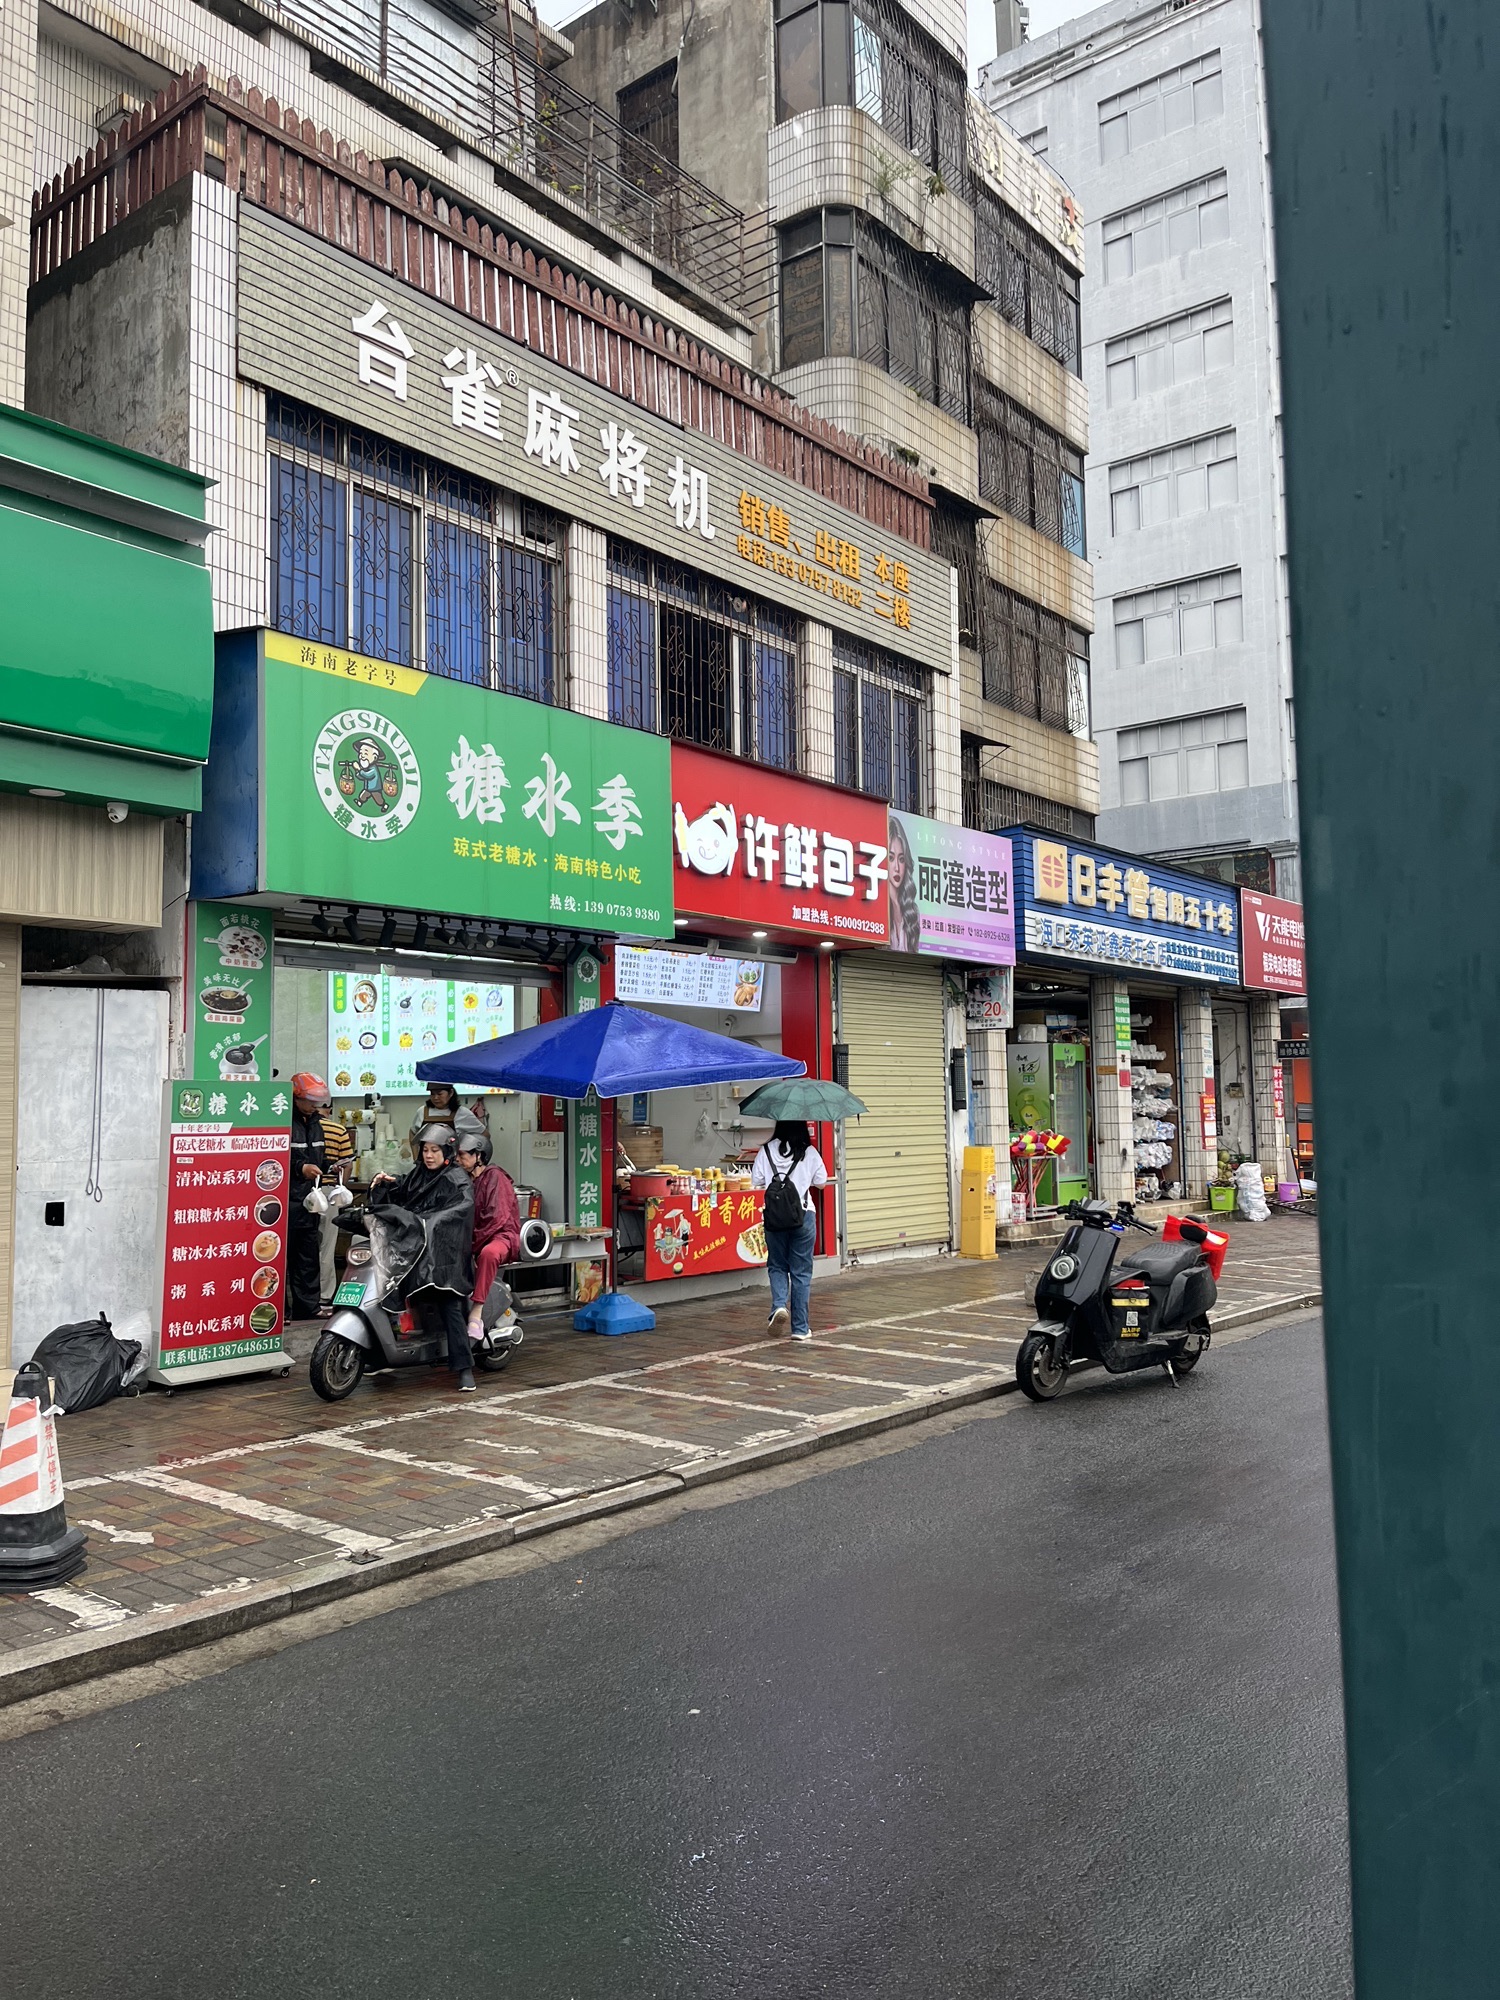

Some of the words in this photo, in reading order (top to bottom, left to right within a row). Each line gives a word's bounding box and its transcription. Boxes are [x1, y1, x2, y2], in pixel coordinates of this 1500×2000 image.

[351, 299, 716, 541] 台雀麻将机
[738, 490, 861, 581] 销售、出租
[874, 552, 910, 594] 本座
[873, 592, 911, 631] 二楼
[300, 645, 397, 687] 海南老字号
[316, 712, 419, 788] TANGSHUIJI
[445, 734, 644, 851] 糖水季
[334, 804, 403, 838] 糖水季
[744, 812, 889, 901] 许鲜包子
[917, 832, 962, 850] LITONG
[971, 845, 1005, 860] STYLE
[918, 856, 1009, 915] 丽潼造型
[1071, 854, 1150, 919] 日丰管
[1150, 886, 1234, 936] 管用五十年
[219, 913, 261, 930] 面若桃花
[584, 900, 604, 914] 139
[606, 904, 633, 918] 0753
[635, 906, 660, 921] 9380
[203, 973, 241, 987] 美味无比
[208, 1091, 289, 1116] 糖水季
[179, 1124, 221, 1133] 十年老字号
[175, 1139, 226, 1152] 琼式老糖水
[230, 1136, 288, 1151] 临高特色小吃
[175, 1169, 251, 1188] 清补凉系列
[173, 1205, 249, 1225] 粗粮糖水系列
[171, 1241, 248, 1262] 糖冰水系列
[170, 1278, 245, 1300] 粥系列
[168, 1314, 245, 1338] 特色小吃系列
[44, 1422, 57, 1495] 禁止停车
